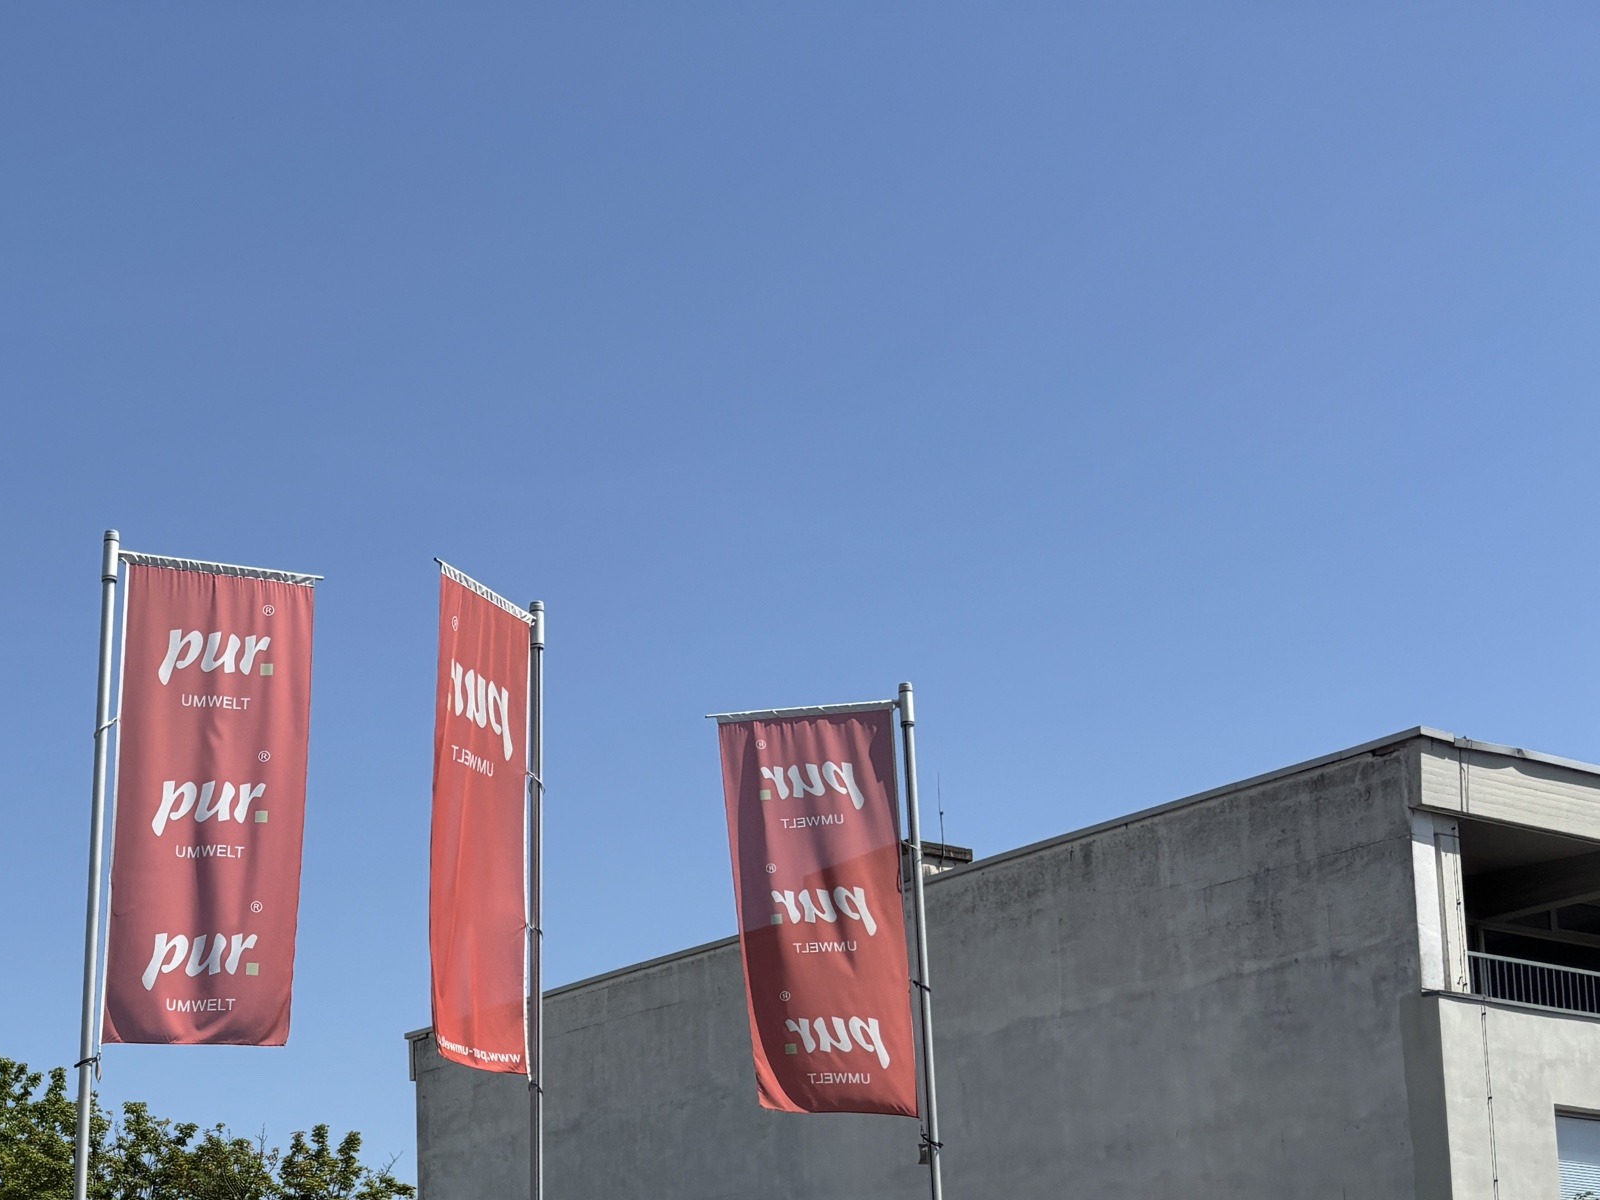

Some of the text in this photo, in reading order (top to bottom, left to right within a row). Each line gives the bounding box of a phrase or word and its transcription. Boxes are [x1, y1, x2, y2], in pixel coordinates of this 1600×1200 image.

[181, 694, 251, 710] UMWELT
[175, 844, 245, 859] UMWELT
[165, 998, 236, 1012] UMWELT
